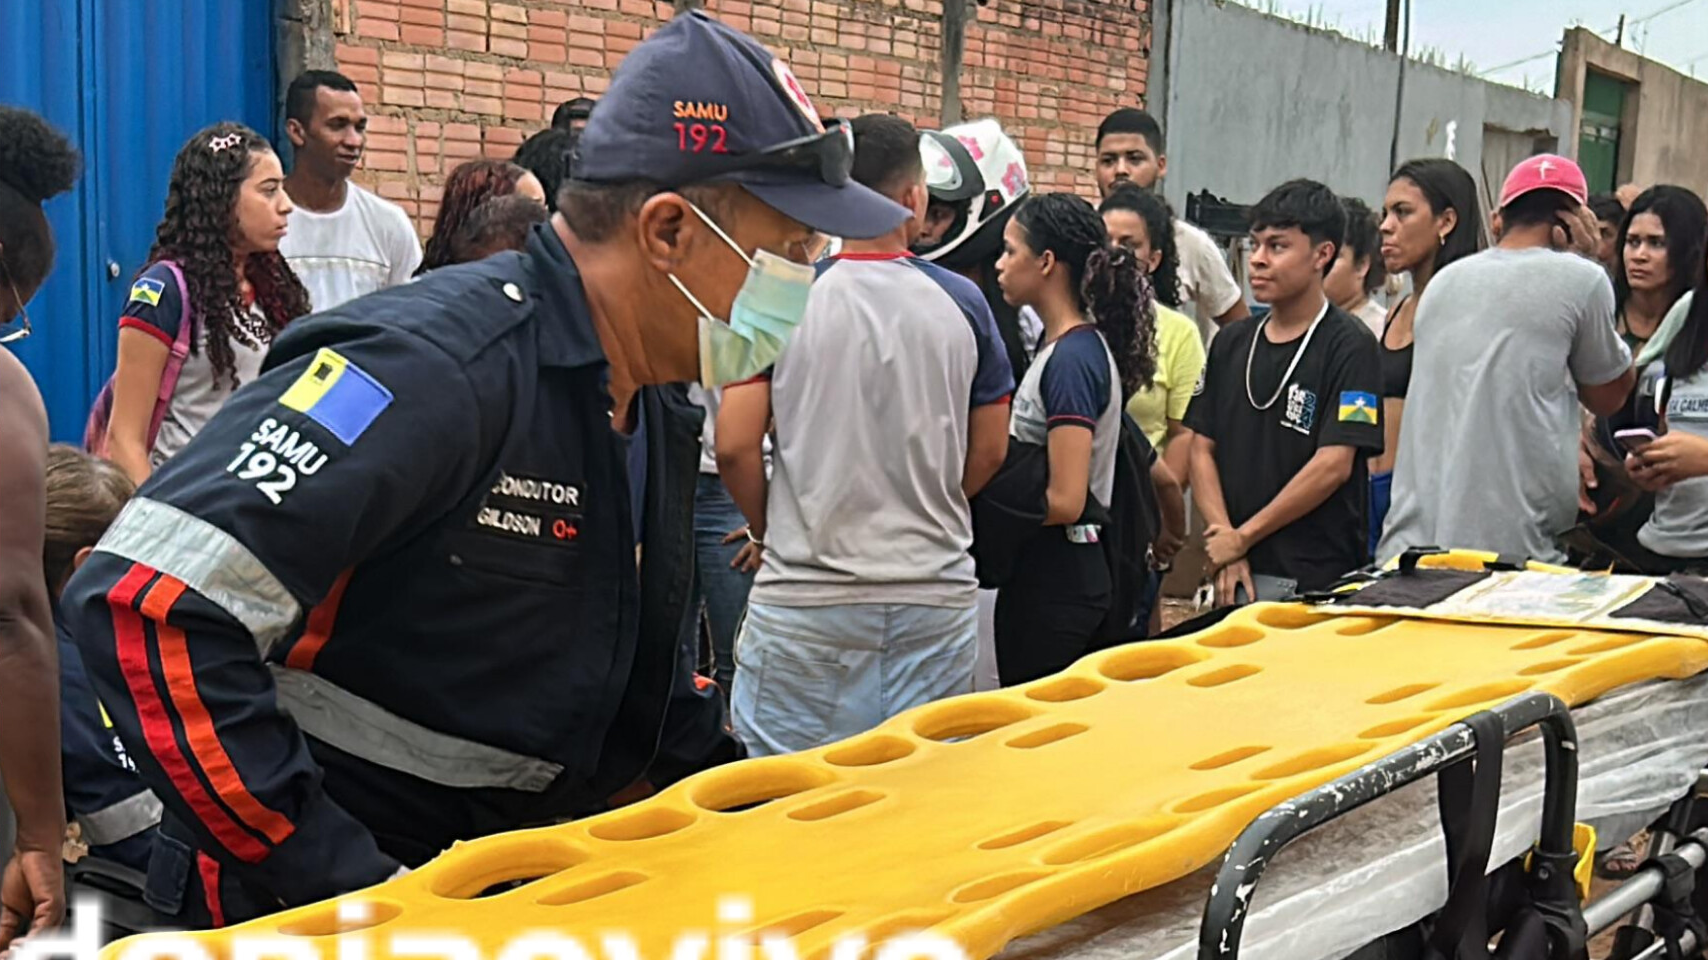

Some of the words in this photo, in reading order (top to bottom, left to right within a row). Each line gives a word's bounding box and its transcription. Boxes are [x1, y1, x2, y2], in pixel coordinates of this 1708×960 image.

[673, 100, 728, 122] SAMU
[673, 122, 728, 153] 192
[251, 417, 329, 476] SAMU
[226, 442, 297, 505] 192
